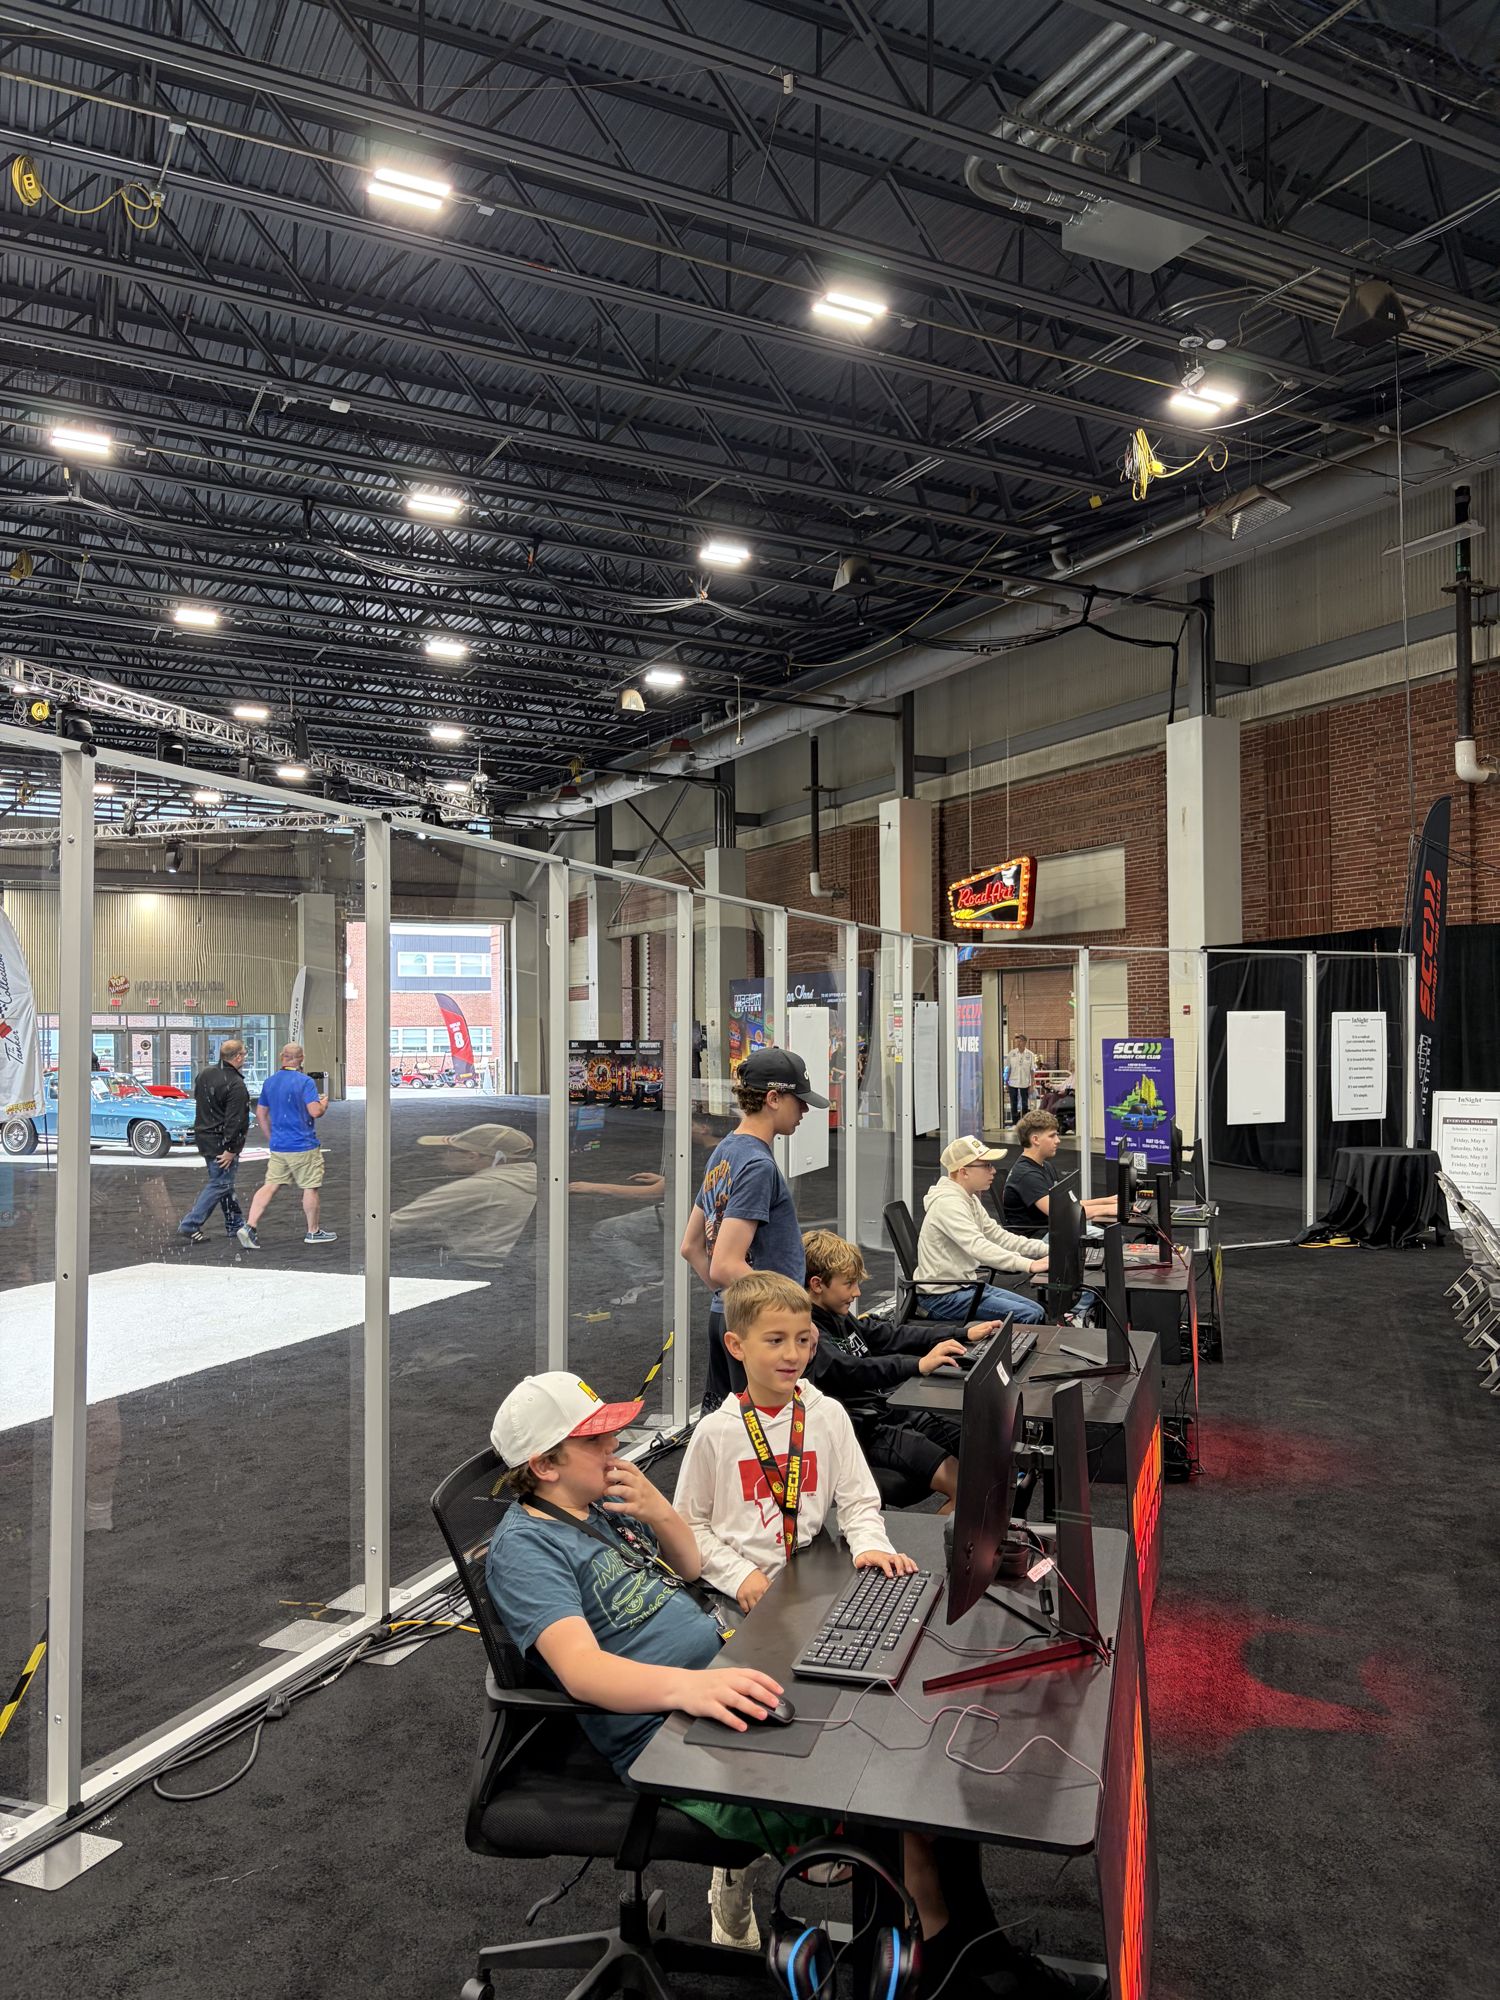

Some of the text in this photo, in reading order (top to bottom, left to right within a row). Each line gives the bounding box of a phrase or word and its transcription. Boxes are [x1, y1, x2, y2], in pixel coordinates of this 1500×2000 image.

[957, 880, 1015, 908] Road Art
[110, 977, 126, 987] POP
[134, 981, 224, 992] YOUTH PAVILION
[1430, 957, 1438, 1021] SUNDAY
[454, 1031, 465, 1049] 8
[1113, 1042, 1144, 1055] SCC
[1421, 1037, 1432, 1115] AUCTIONS
[744, 1410, 769, 1462] MECUM
[785, 1455, 801, 1509] MECUM
